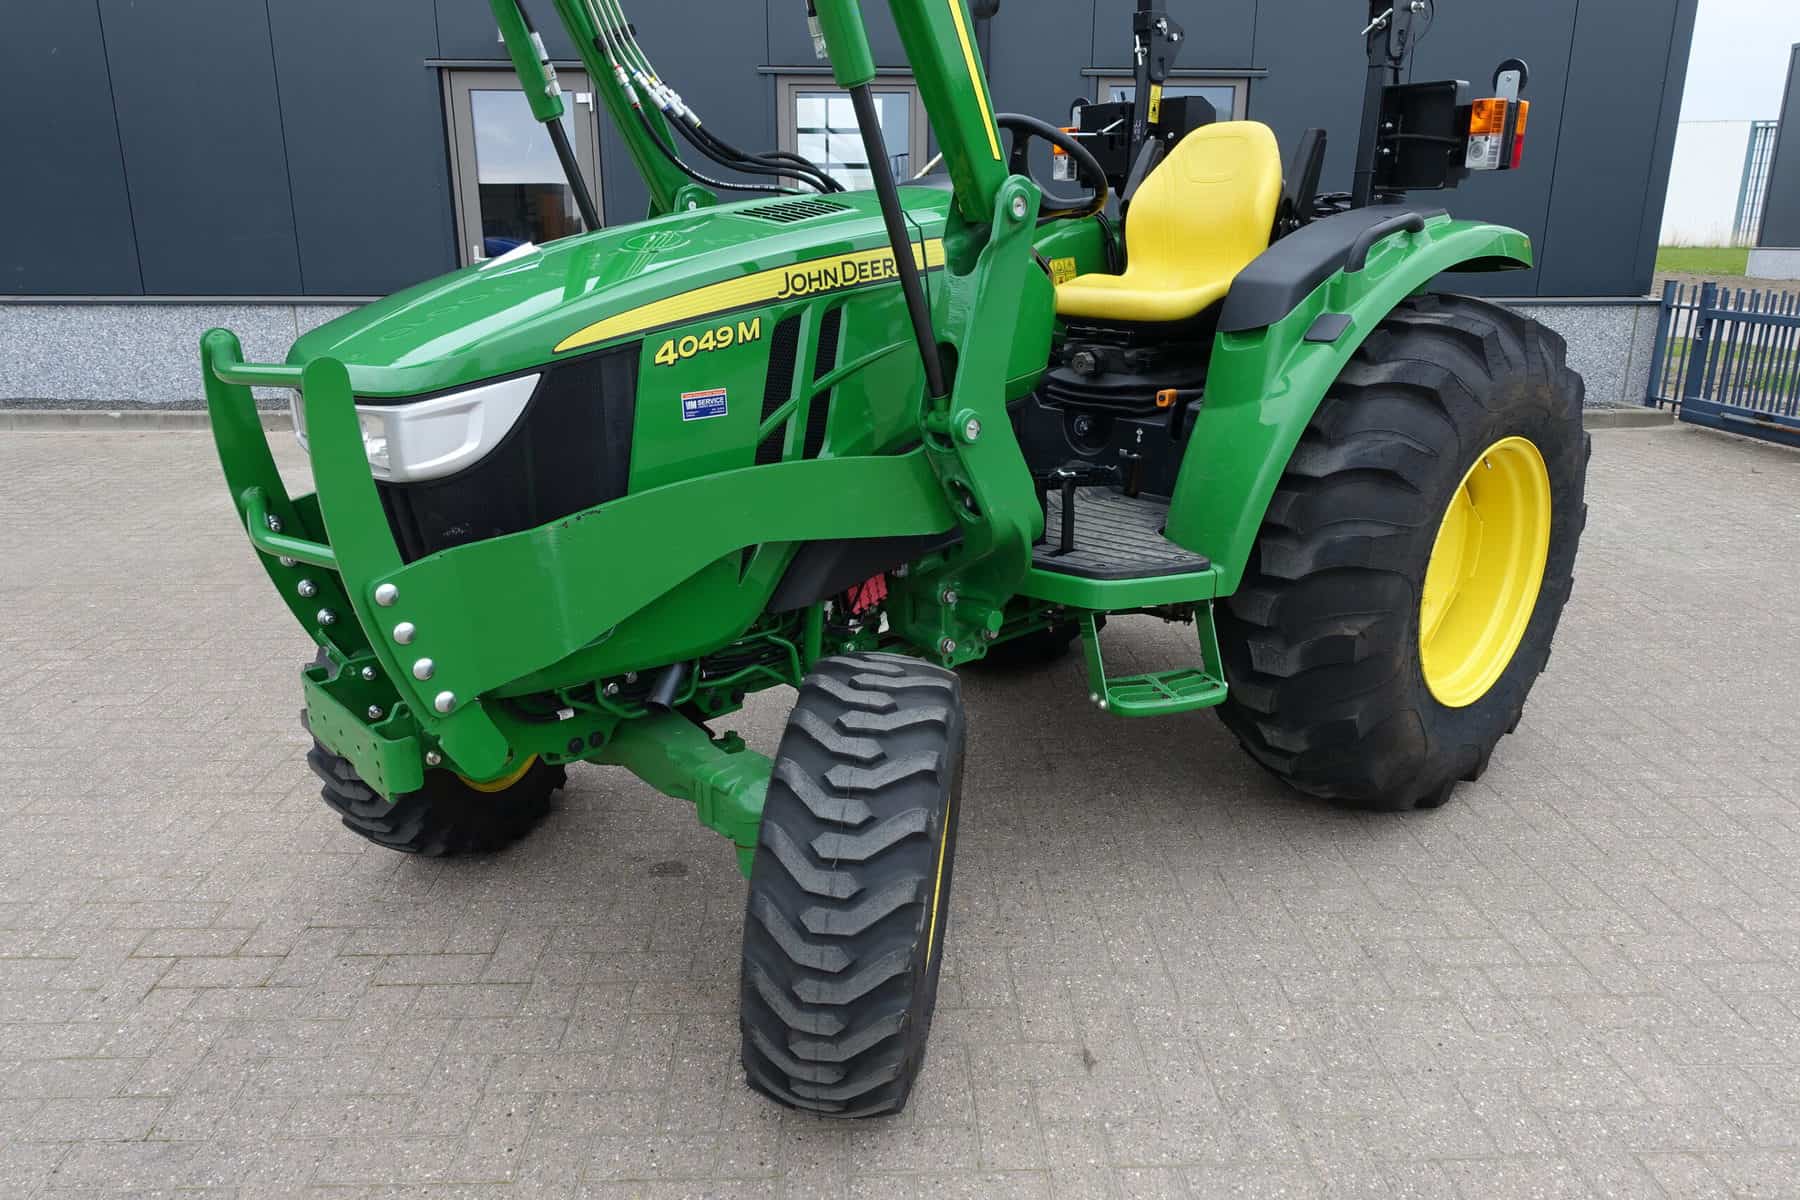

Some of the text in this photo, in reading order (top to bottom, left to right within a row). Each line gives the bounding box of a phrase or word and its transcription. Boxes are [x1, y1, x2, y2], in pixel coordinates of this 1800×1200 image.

[778, 258, 898, 295] JOHN DEER
[697, 396, 725, 406] SERVICE
